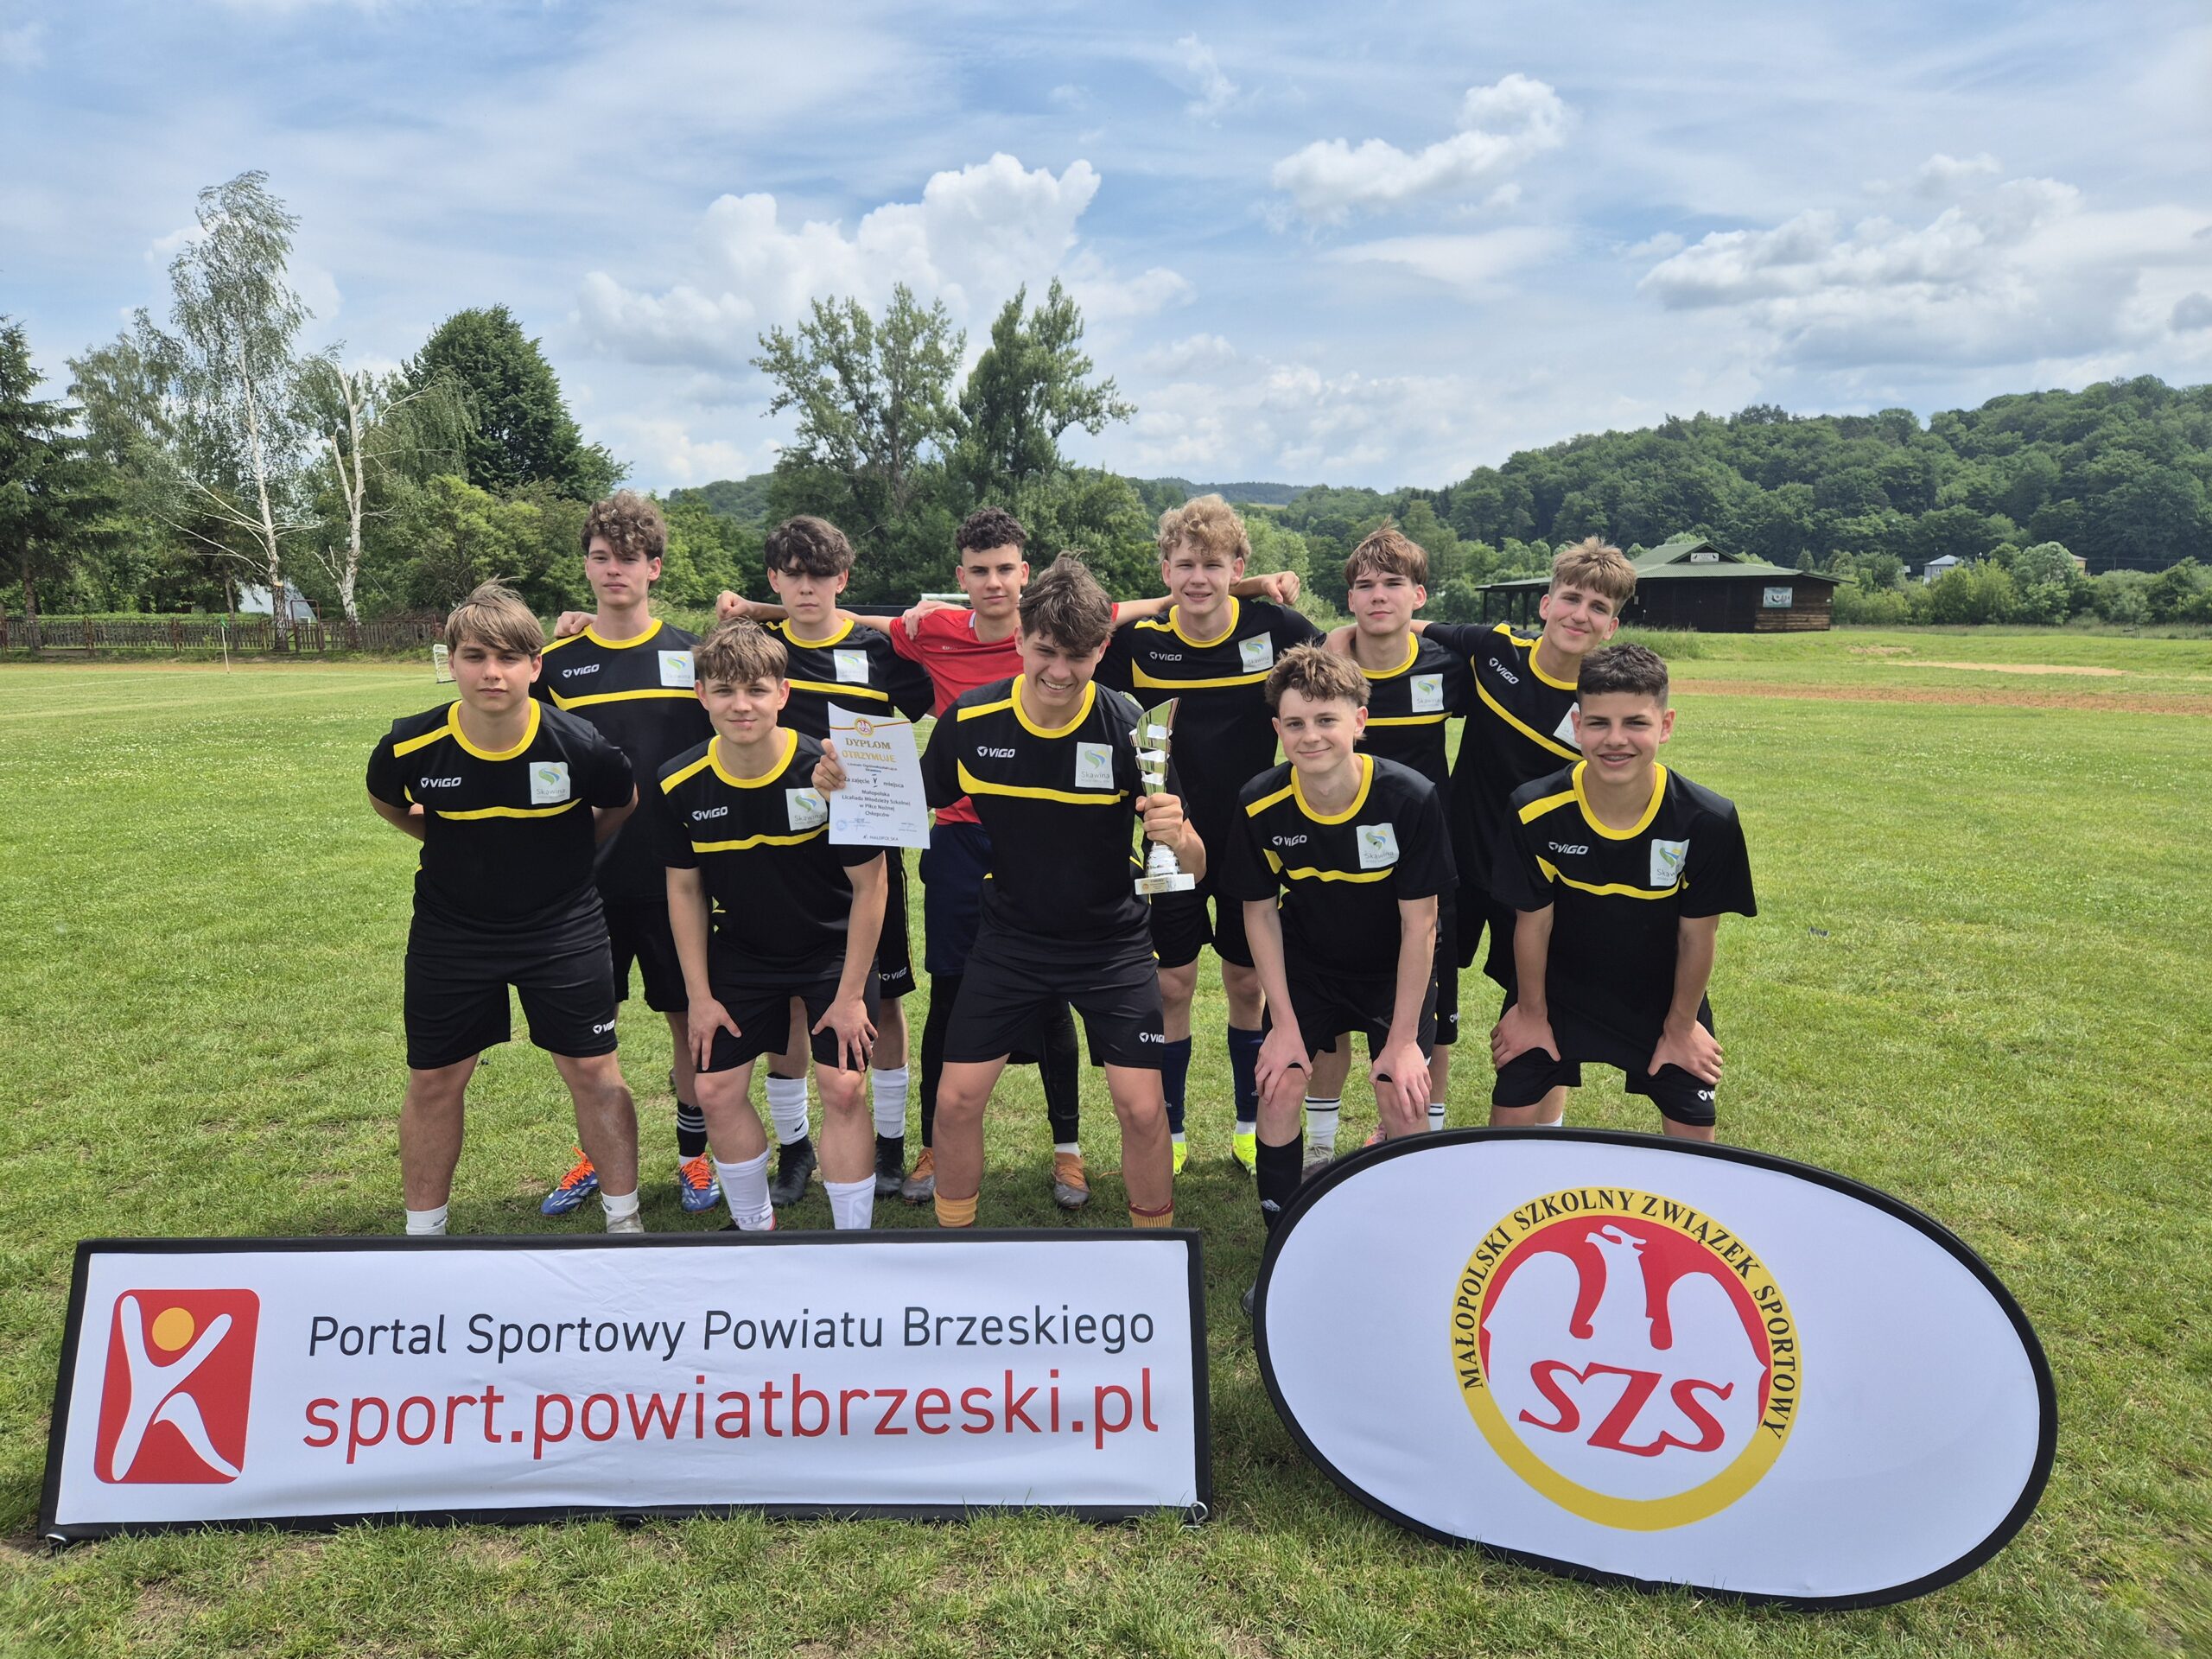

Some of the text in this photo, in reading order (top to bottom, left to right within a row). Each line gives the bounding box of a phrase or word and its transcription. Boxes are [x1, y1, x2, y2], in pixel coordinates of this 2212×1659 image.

[842, 750, 897, 762] OTRZYMUJE
[845, 738, 892, 749] DYPLOM
[309, 1305, 1154, 1364] Portal Sportowy Powiatu Brzeskiego
[1455, 1189, 1796, 1440] MAŁOPOLSKI SZKOLNY ZWIĄZEK SPORTOWY
[302, 1367, 1159, 1465] sport.powiatbrzeski.pl
[1518, 1359, 1734, 1458] SZS
